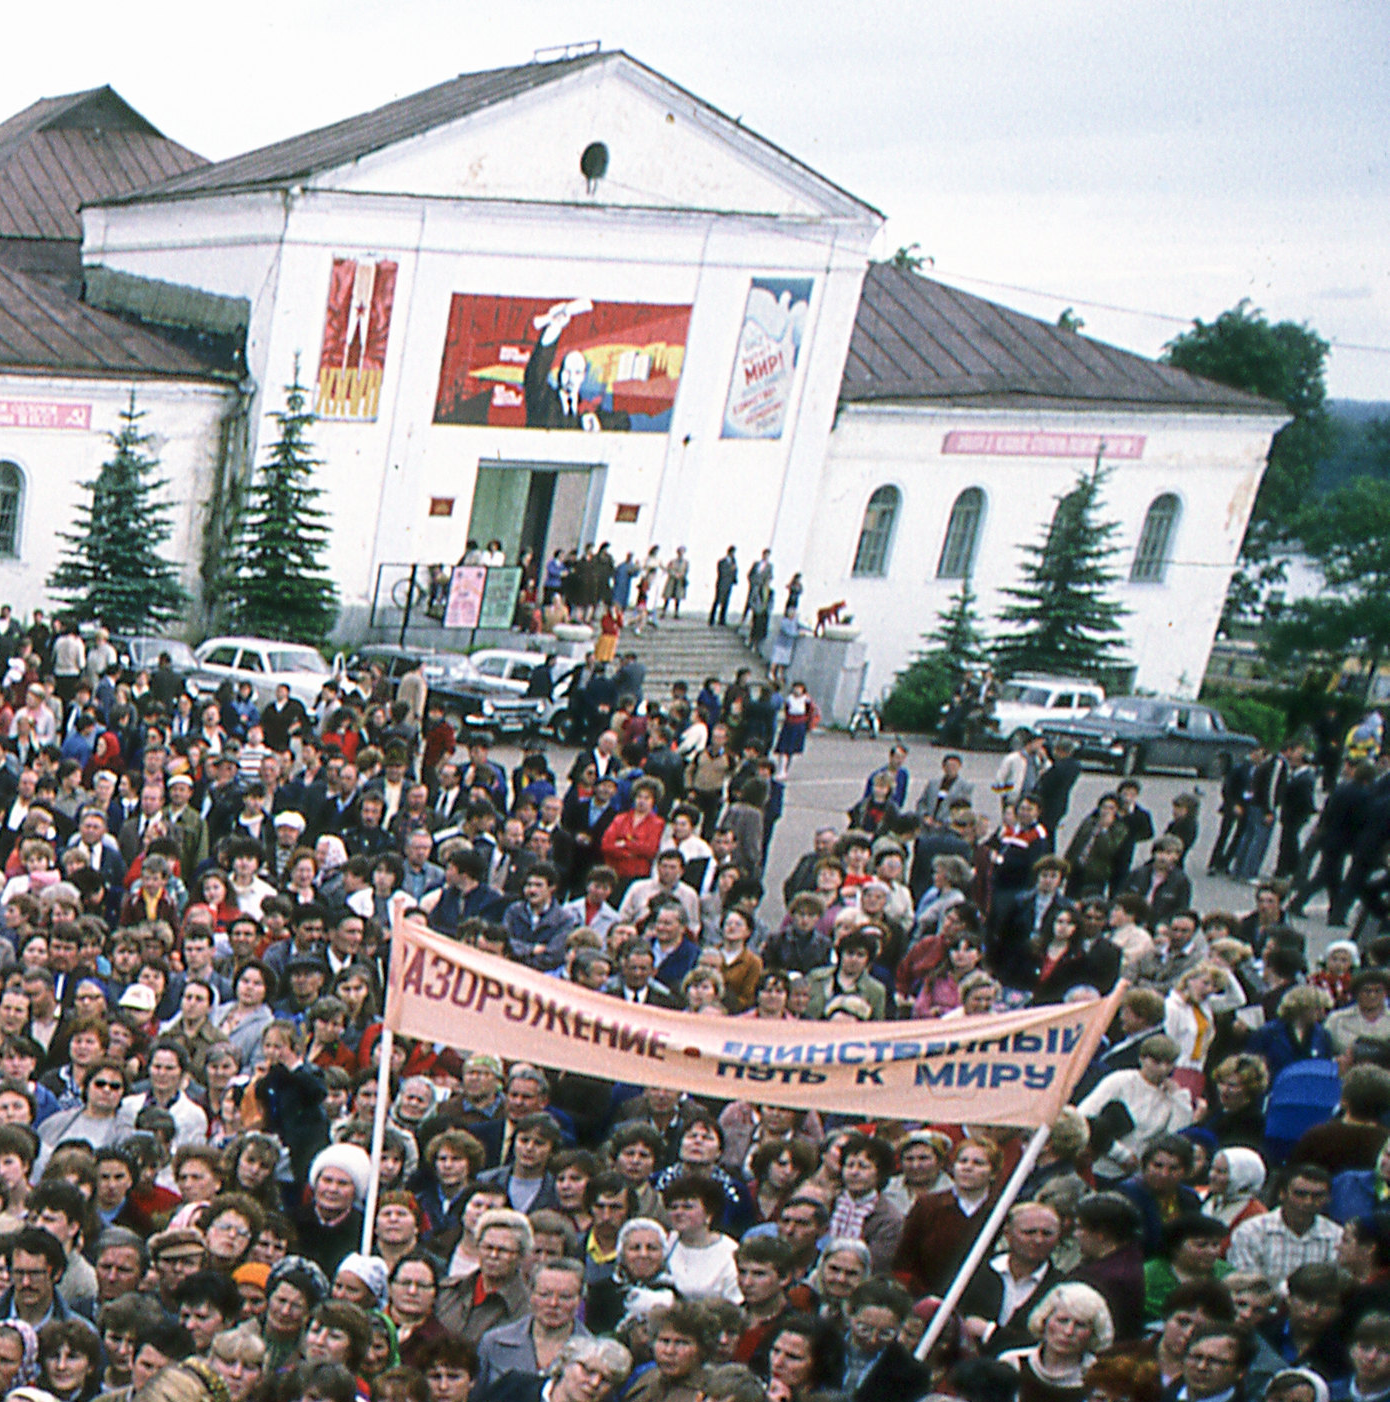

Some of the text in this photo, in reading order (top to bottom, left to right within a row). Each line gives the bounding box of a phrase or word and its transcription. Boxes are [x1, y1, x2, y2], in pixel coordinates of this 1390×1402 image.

[403, 944, 672, 1062] АЗОРУЖЕНИЕ
[716, 1061, 829, 1085] ПУТЬ
[914, 1061, 1057, 1091] МИРУ
